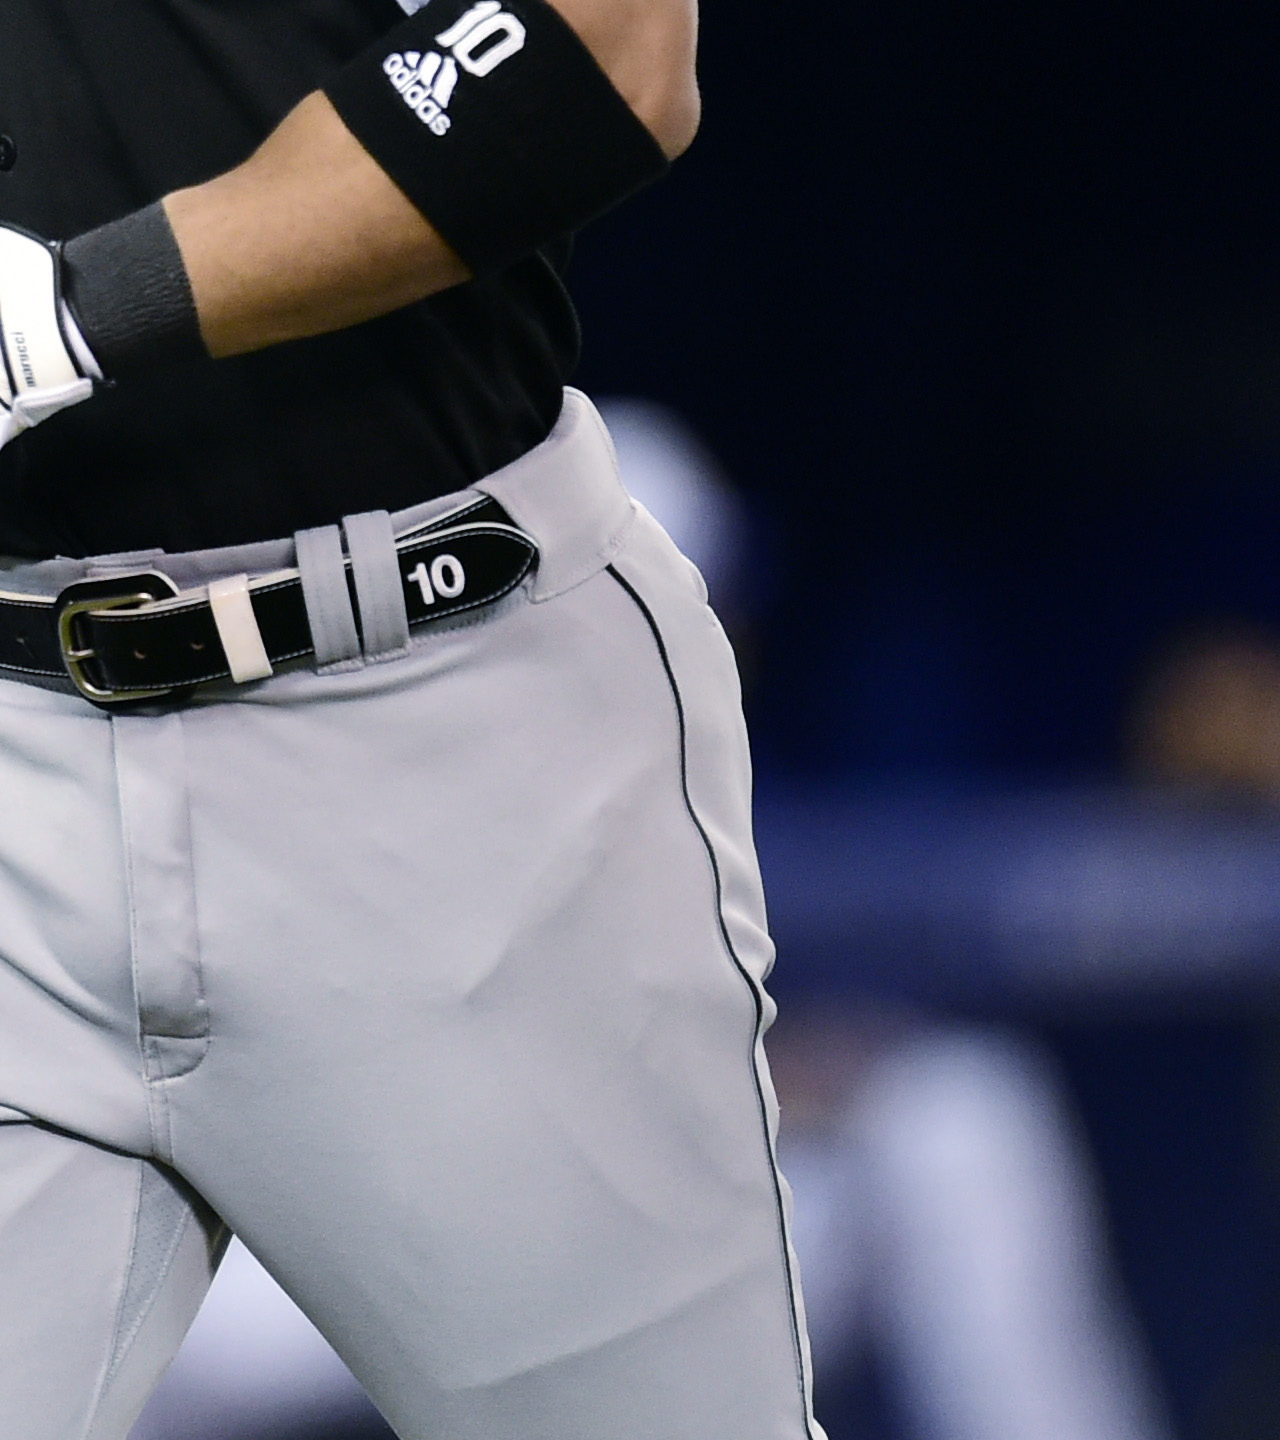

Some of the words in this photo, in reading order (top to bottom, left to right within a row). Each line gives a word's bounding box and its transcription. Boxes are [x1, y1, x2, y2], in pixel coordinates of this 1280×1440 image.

[434, 0, 527, 78] 10
[382, 51, 452, 137] adidas
[406, 553, 466, 606] 10
